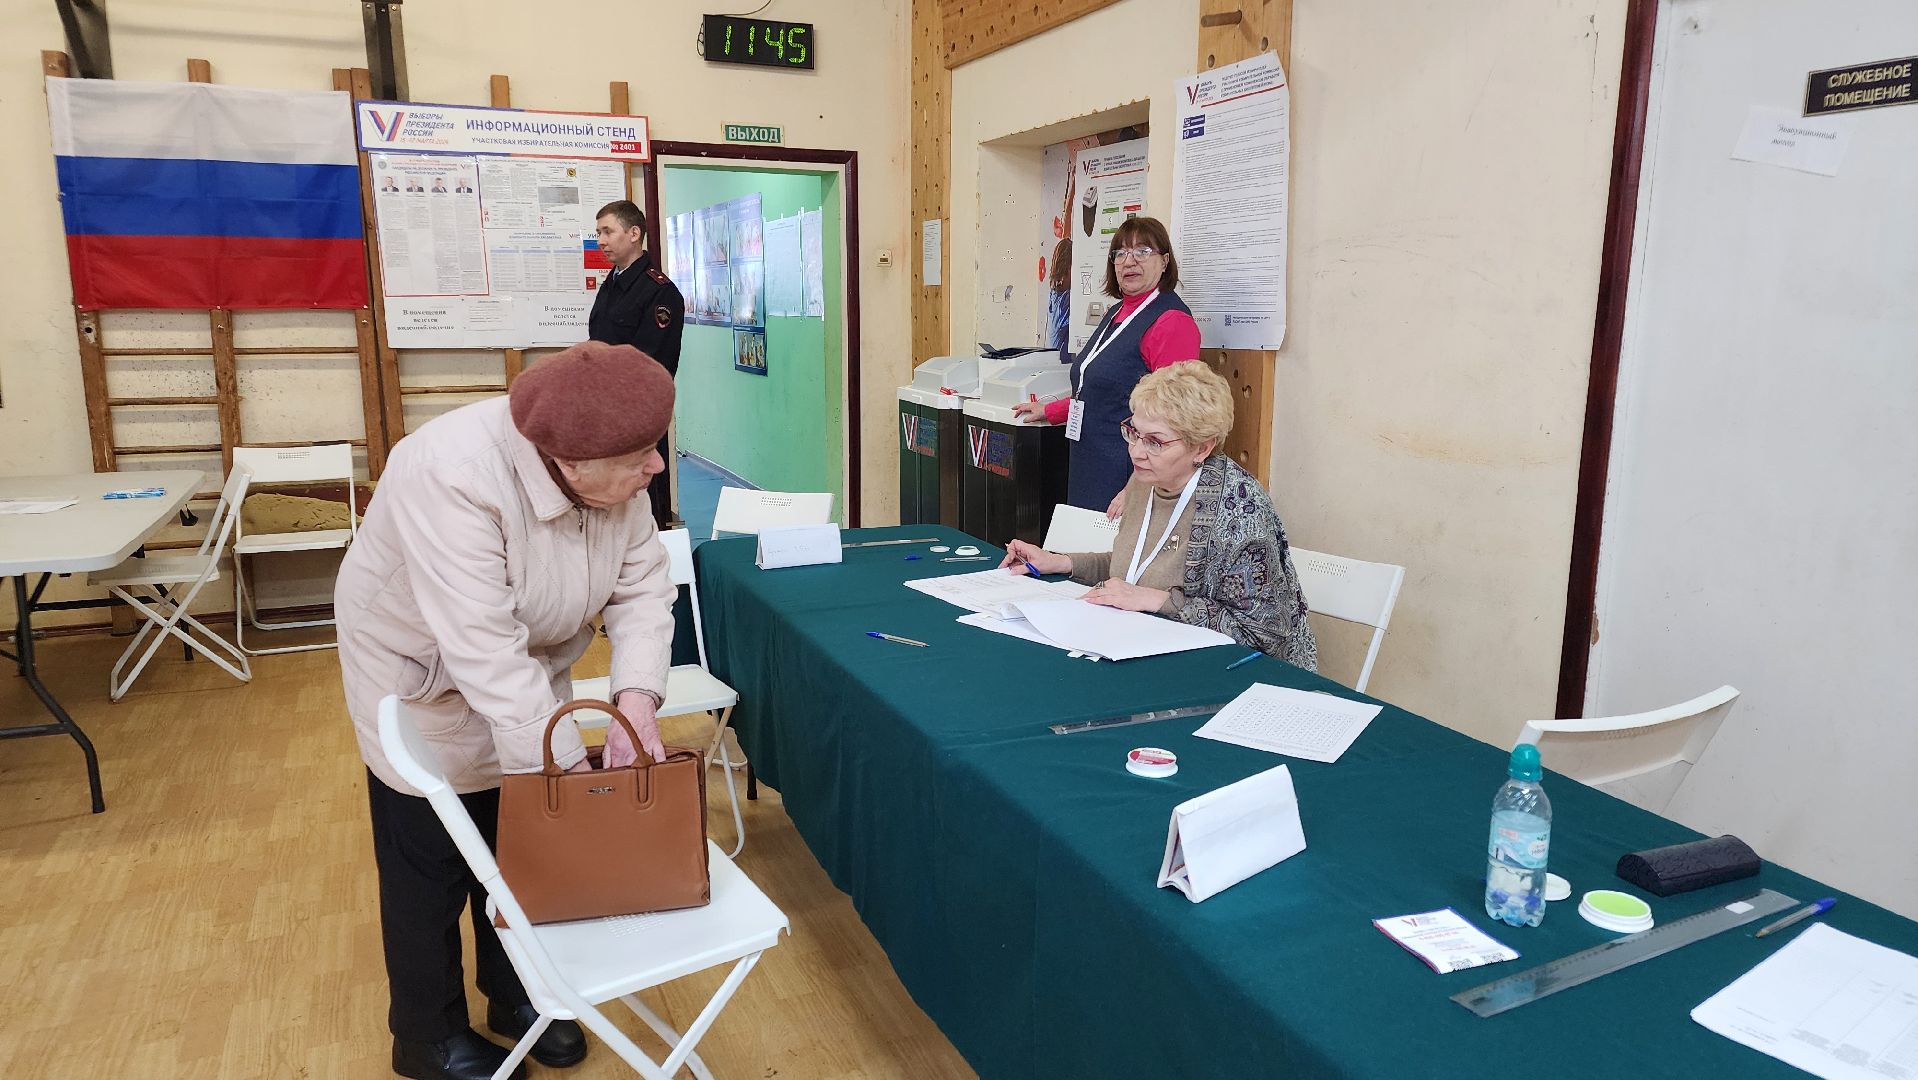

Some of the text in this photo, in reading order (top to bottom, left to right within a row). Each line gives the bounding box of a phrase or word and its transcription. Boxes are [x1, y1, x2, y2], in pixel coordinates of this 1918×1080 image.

[1827, 63, 1913, 89] СЛУЖЕБНОЕ
[1823, 83, 1912, 108] ПОМЕЩЕНИЕ
[408, 112, 443, 120] ВЫБОРЫ
[405, 120, 455, 130] ПРЕЗИДЕНТА
[466, 119, 636, 140] ИНФОРМАЦИОННЫЙ СТЕНД
[402, 129, 434, 137] РОССИИ
[728, 126, 779, 143] ВЫХОД
[471, 137, 516, 145] УЧАСТКОВАЯ
[517, 139, 573, 148] ИЗБИРАТЕЛЬНАЯ
[574, 141, 610, 149] КОМИССИЯ
[619, 143, 636, 151] 2401
